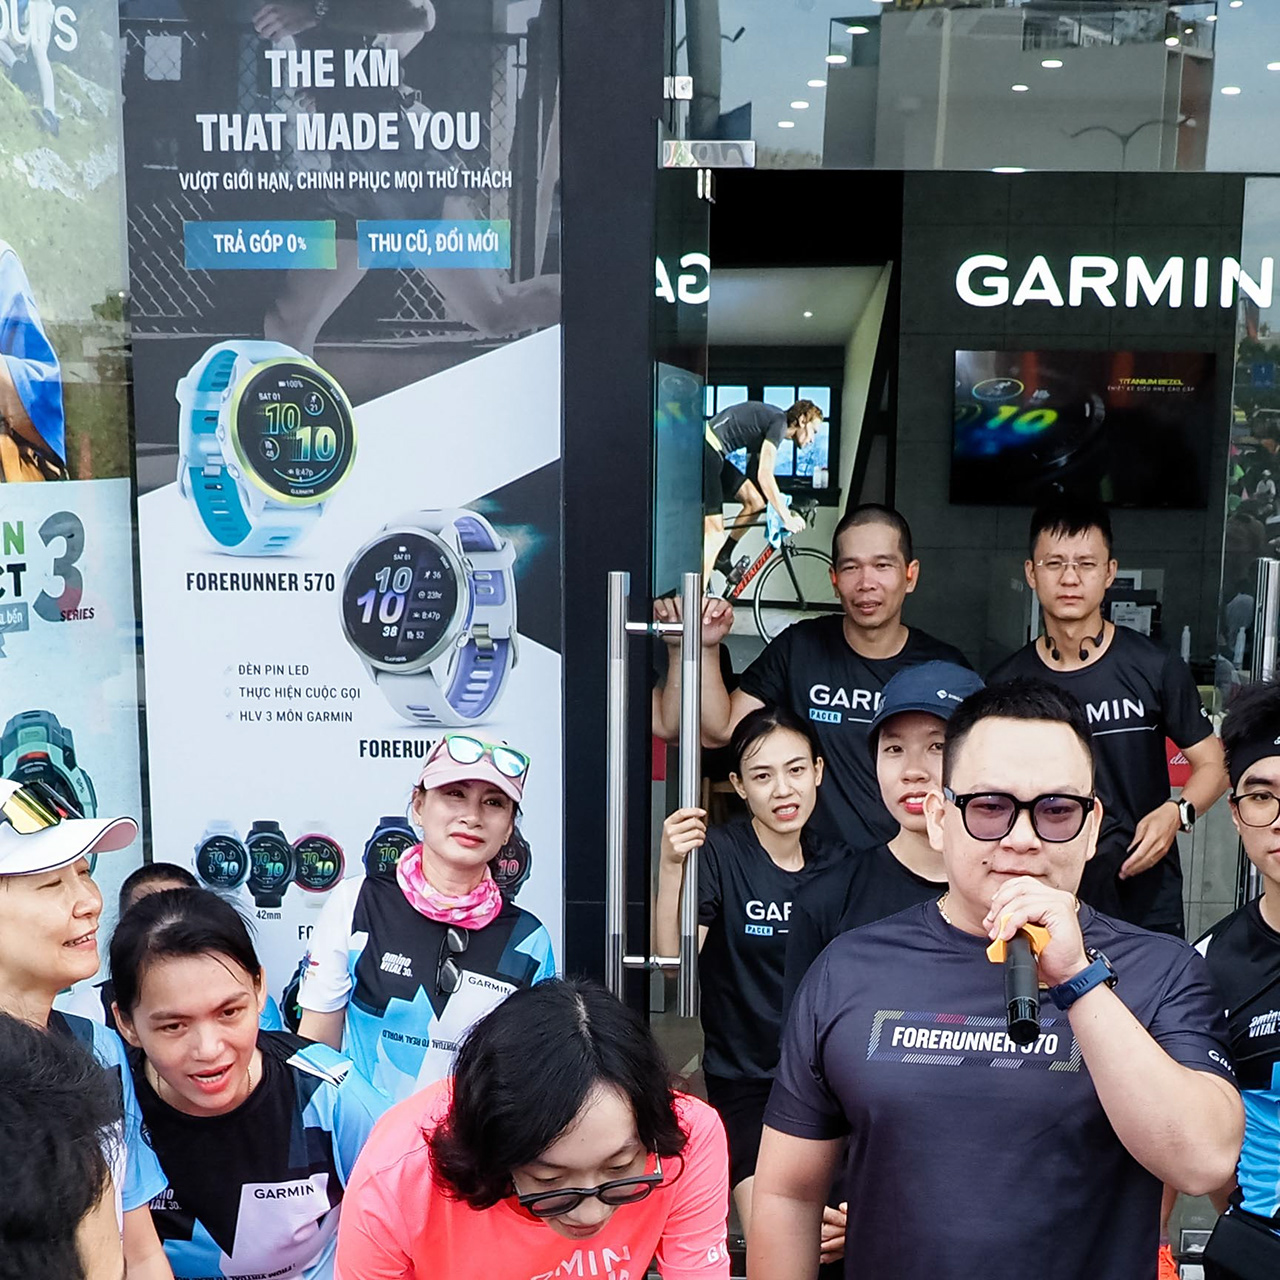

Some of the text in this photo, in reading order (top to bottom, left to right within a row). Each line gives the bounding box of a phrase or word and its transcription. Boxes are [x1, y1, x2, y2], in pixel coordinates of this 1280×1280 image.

[265, 49, 399, 88] THE KM
[196, 111, 479, 152] THAT MADE YOU
[179, 171, 220, 192] VƯỢT
[223, 169, 253, 190] GIỚI
[258, 172, 293, 193] HẠN,
[349, 171, 390, 193] PHỤC
[395, 171, 423, 192] MỌI
[427, 166, 458, 189] THỬ
[463, 167, 511, 189] THÁCH
[214, 230, 306, 253] TRẢ GÓP 0%
[369, 233, 401, 252] THU
[436, 227, 463, 253] ĐỔI
[468, 230, 498, 252] MỚI
[955, 254, 1273, 308] GARMIN
[32, 511, 85, 622] 3
[186, 572, 335, 592] FORERUNNER 570
[376, 567, 413, 593] 10
[60, 607, 95, 622] SERIES
[357, 589, 405, 624] 10
[382, 626, 398, 637] 38
[239, 661, 309, 676] ĐÈN PIN LED
[239, 684, 360, 701] THỰC HIỆN CUỘC GỌI
[240, 709, 353, 723] HLV 3 MÔN GARMIN
[810, 709, 839, 722] PACER
[1086, 698, 1145, 724] MIN
[256, 910, 282, 919] 42mm
[468, 976, 512, 995] GARMIN
[892, 1027, 1016, 1053] FORERUNNER
[254, 1185, 314, 1199] GARMIN
